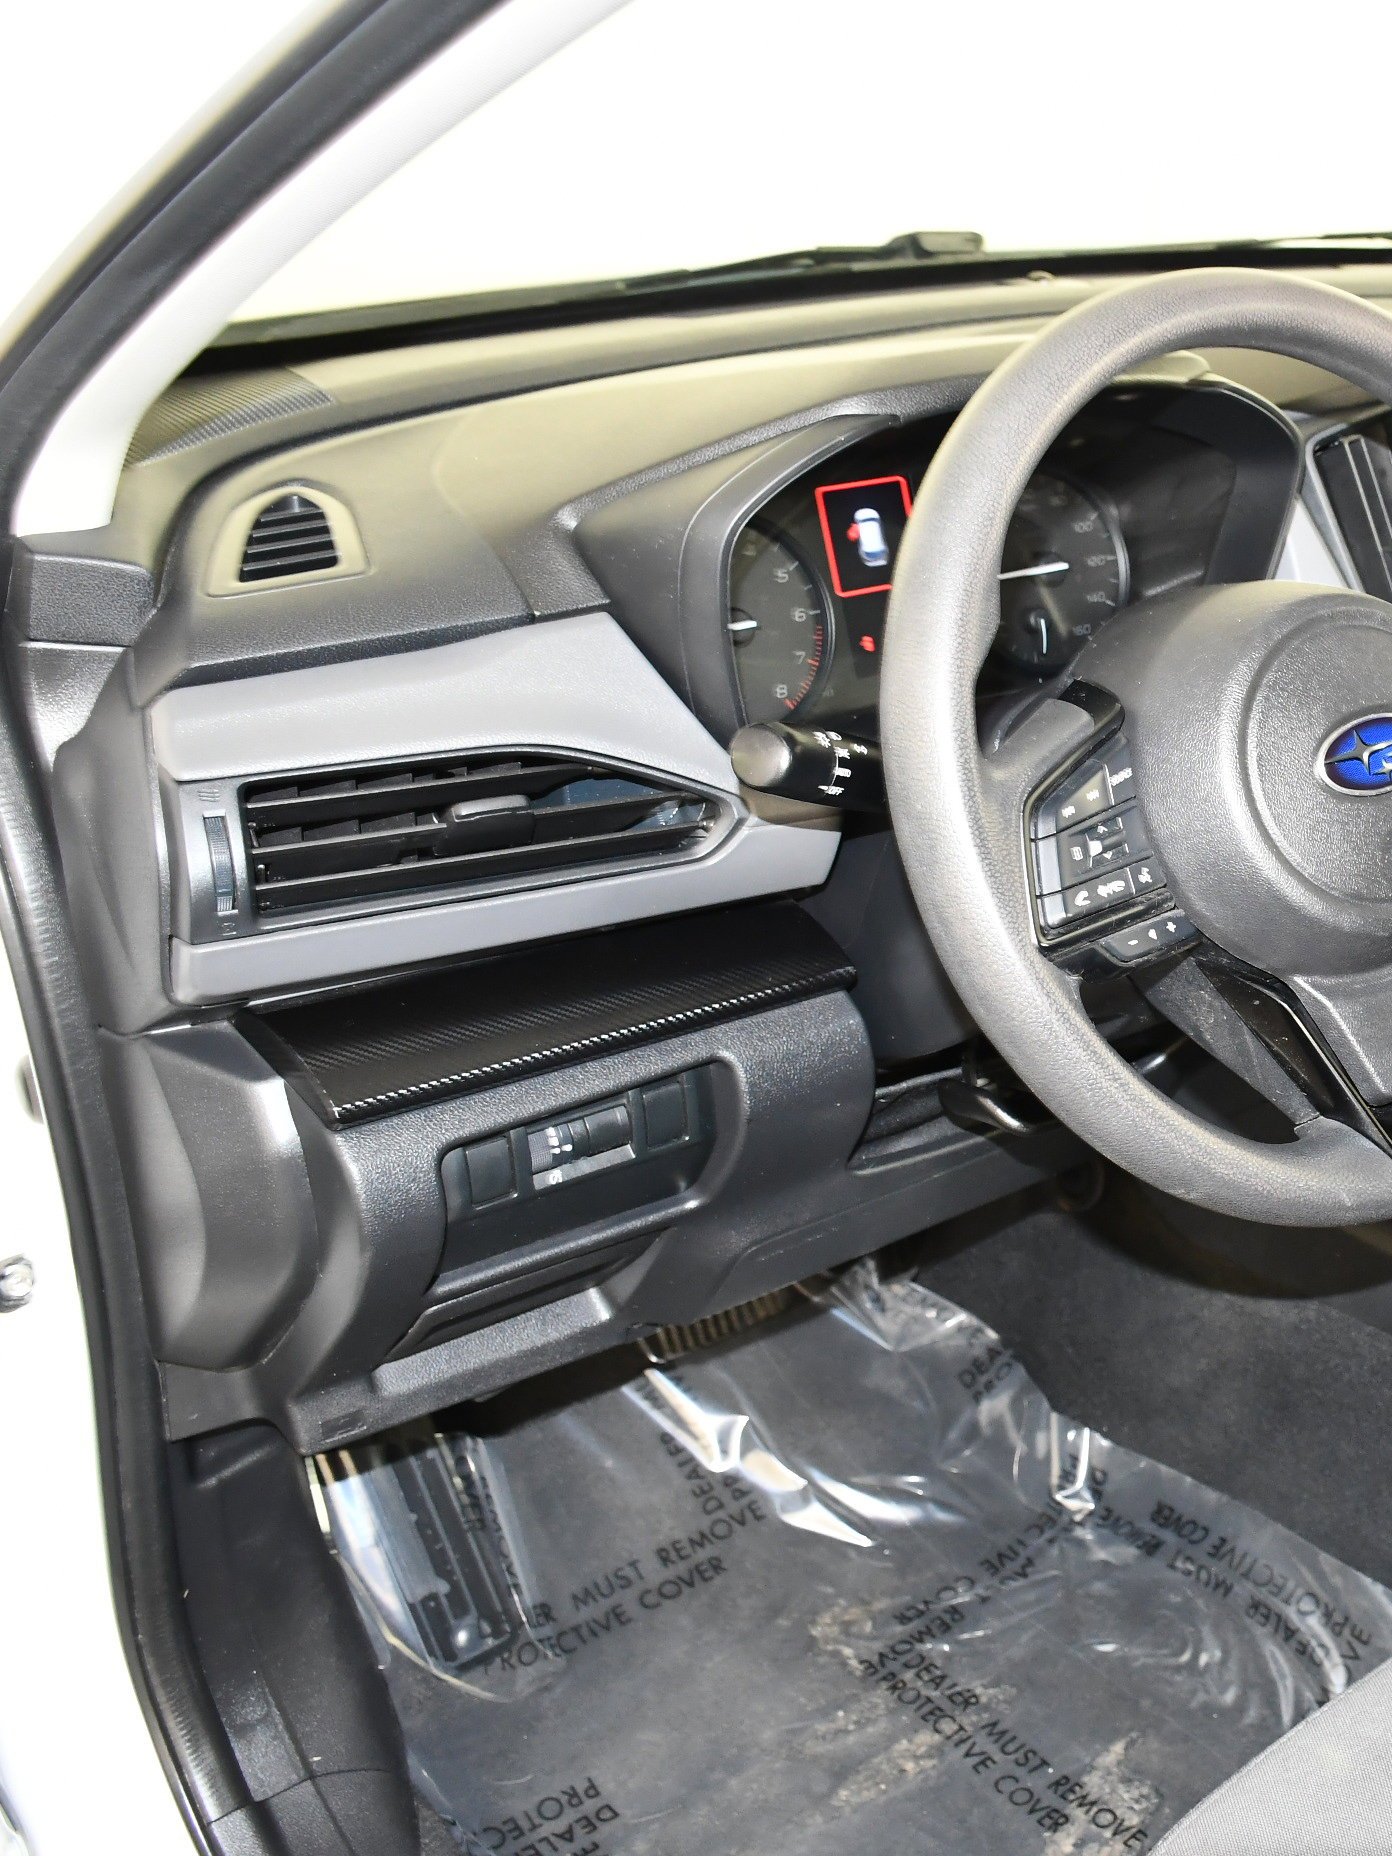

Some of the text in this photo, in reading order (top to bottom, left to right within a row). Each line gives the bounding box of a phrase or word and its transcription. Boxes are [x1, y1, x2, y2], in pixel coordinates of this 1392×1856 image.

[774, 567, 790, 584] 5
[793, 609, 807, 623] 6
[793, 650, 807, 665] 7
[775, 684, 789, 699] 8
[570, 1499, 768, 1612] MUST REMOVE
[637, 1555, 728, 1611] COVER
[875, 1670, 1070, 1834] PROTECTIVE COVER
[901, 1652, 1149, 1850] DEALER MUST REMOVE
